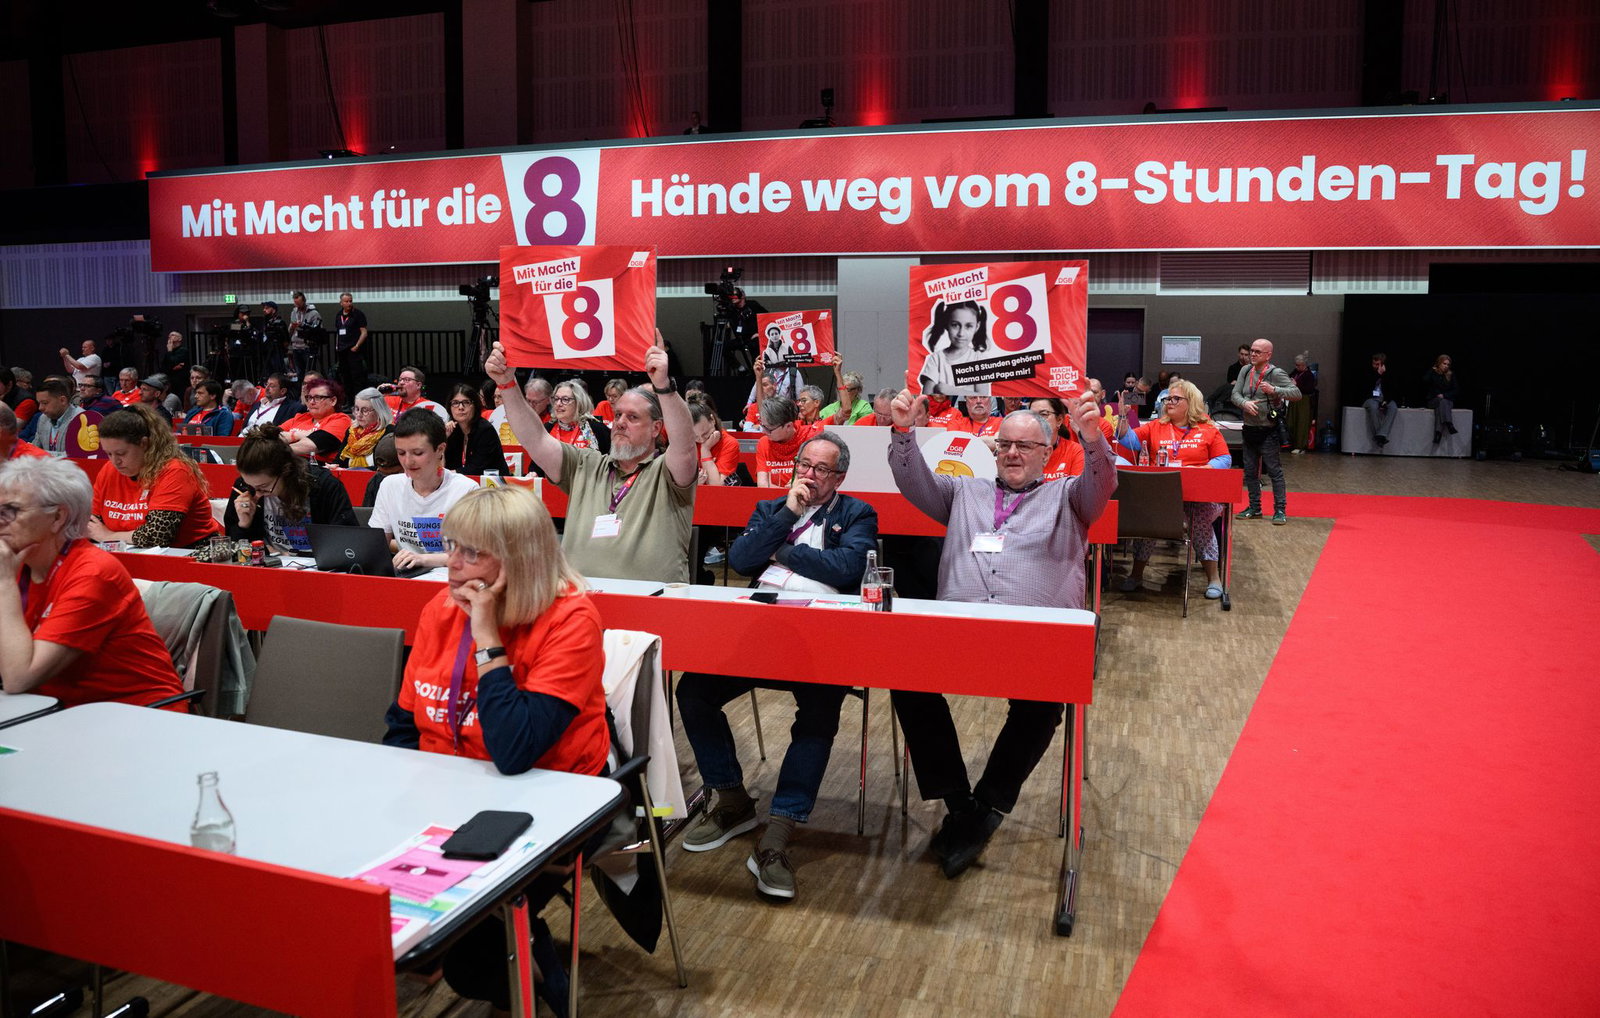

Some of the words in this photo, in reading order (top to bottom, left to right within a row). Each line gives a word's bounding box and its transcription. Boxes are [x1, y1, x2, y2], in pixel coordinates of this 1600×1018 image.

[523, 156, 587, 246] 8
[631, 172, 792, 218] Hände
[801, 176, 912, 225] weg
[924, 172, 1051, 210] vom
[182, 198, 237, 238] Mit
[244, 195, 364, 236] Macht
[371, 189, 430, 229] für
[436, 183, 501, 226] die
[516, 268, 536, 281] Mit
[538, 260, 577, 276] Macht
[534, 281, 552, 292] für
[554, 278, 573, 290] die
[928, 281, 946, 294] Mit
[947, 271, 985, 288] Macht
[945, 291, 962, 303] für
[964, 287, 982, 299] die
[561, 286, 603, 351] 8
[990, 284, 1037, 352] 8
[790, 328, 811, 354] 8
[955, 366, 974, 375] Nach
[980, 360, 1011, 370] Stunden
[1011, 354, 1042, 366] gehören
[957, 376, 980, 384] Mama
[996, 371, 1015, 379] Papa
[1015, 368, 1031, 376] mir!
[1056, 372, 1077, 380] DICH
